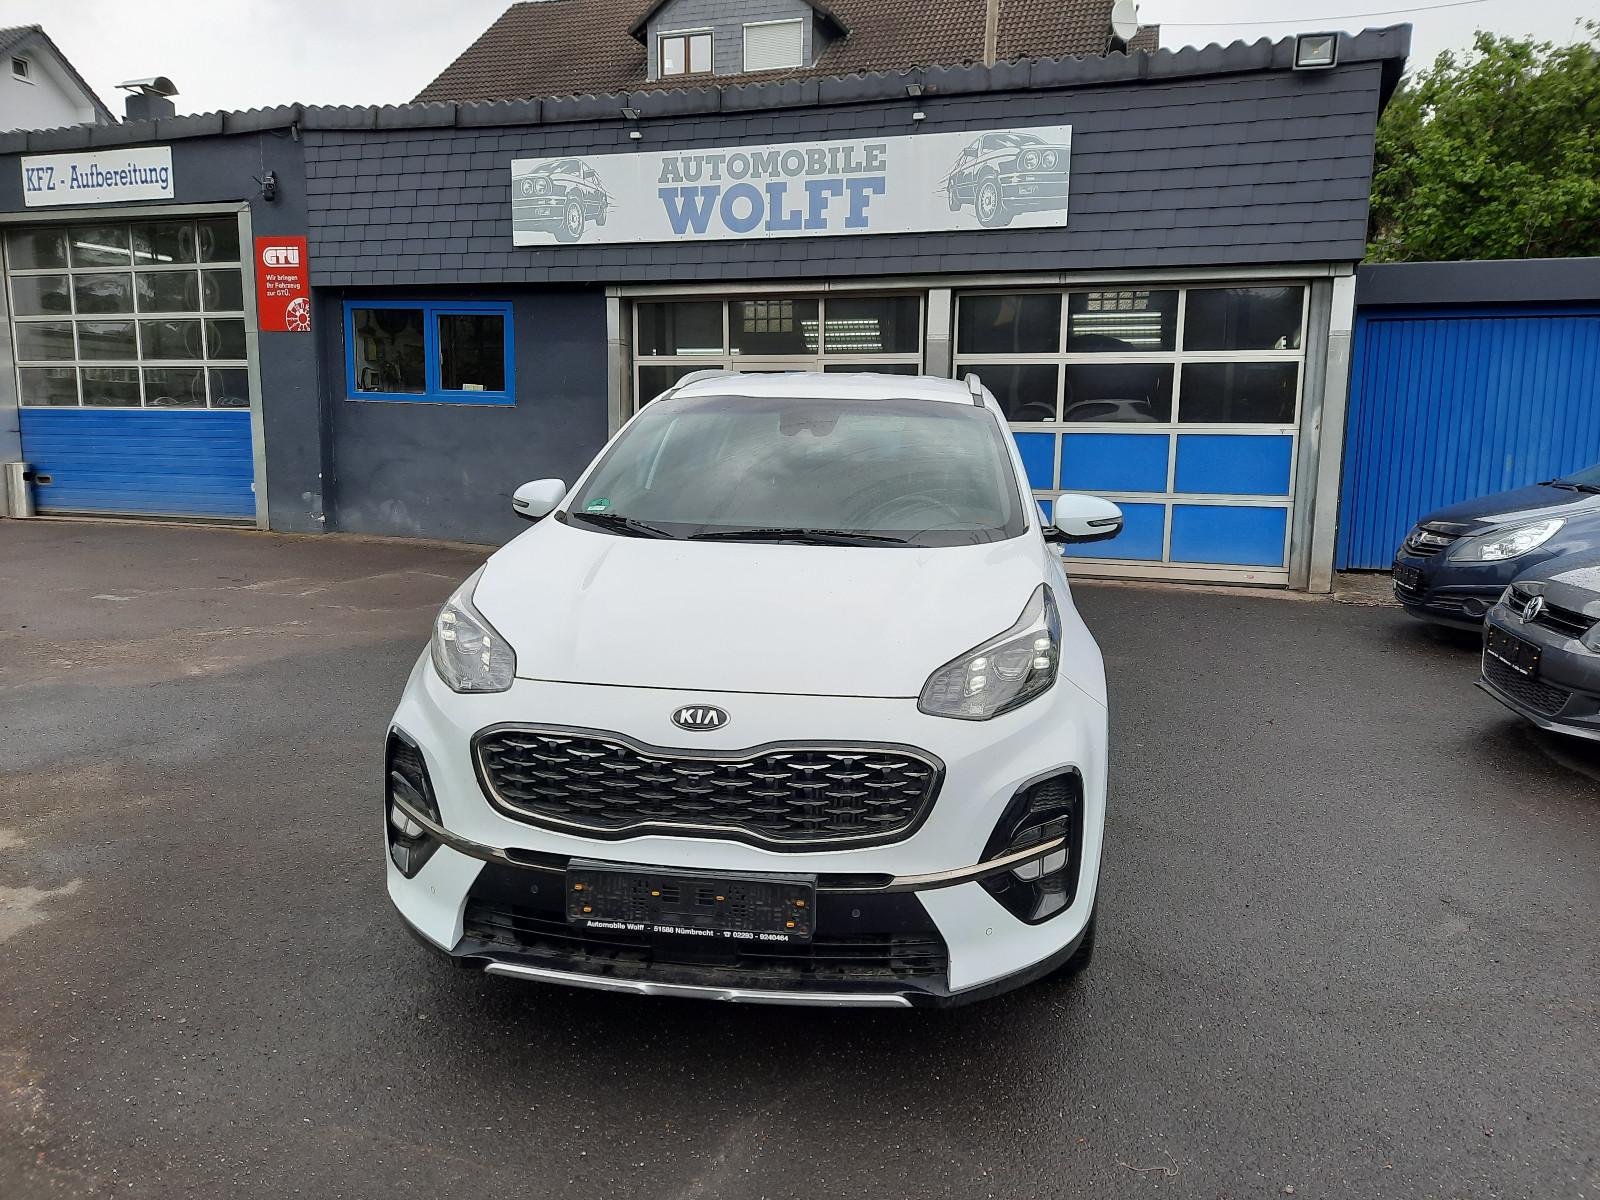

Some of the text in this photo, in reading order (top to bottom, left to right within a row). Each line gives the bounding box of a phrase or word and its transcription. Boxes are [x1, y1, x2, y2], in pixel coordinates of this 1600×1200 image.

[658, 144, 886, 183] AUTOMOBILE
[26, 167, 56, 191] KFZ
[70, 163, 169, 189] Aufbereitung
[658, 176, 885, 234] WOLFF
[275, 282, 300, 290] Fahrzeug
[277, 289, 290, 297] GTÜ.
[680, 709, 719, 725] KIA
[587, 921, 625, 929] Automobile
[675, 928, 714, 936] Nümbrecht
